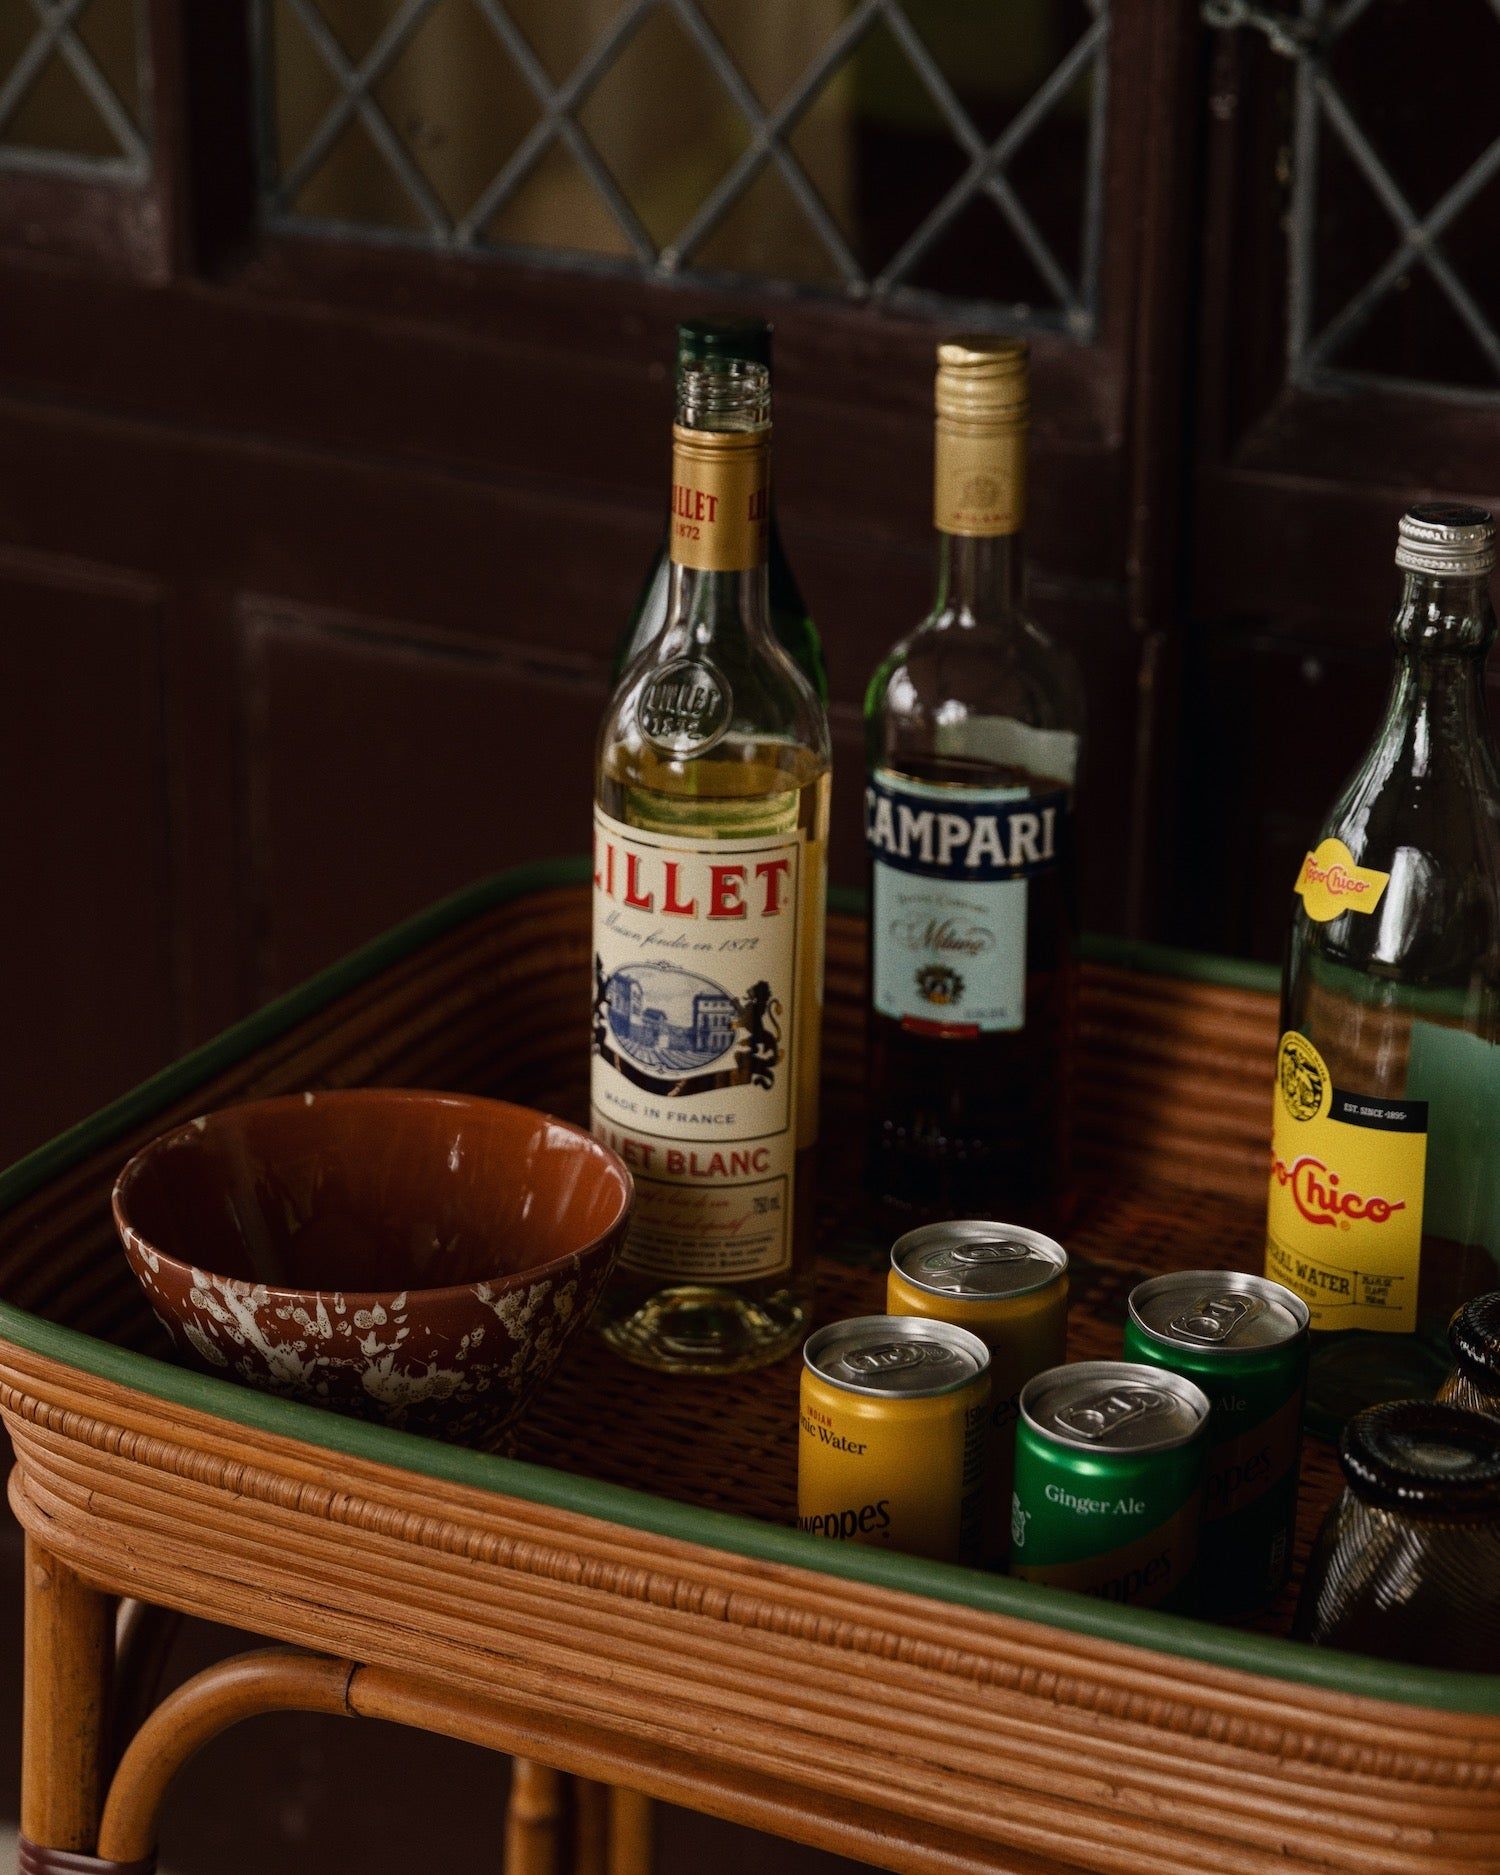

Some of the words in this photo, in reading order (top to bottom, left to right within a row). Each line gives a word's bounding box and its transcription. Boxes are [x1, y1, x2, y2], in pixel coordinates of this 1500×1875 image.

[604, 1092, 638, 1115] MADE
[643, 1108, 660, 1119] IN
[667, 1112, 737, 1125] FRANCE
[1360, 1106, 1384, 1119] SINCE
[667, 1146, 770, 1177] BLANC
[1292, 1158, 1407, 1228] Chico
[1295, 1260, 1351, 1295] WATER
[818, 1426, 868, 1455] Water
[1045, 1484, 1111, 1515] Ginger
[1112, 1497, 1146, 1515] Ale
